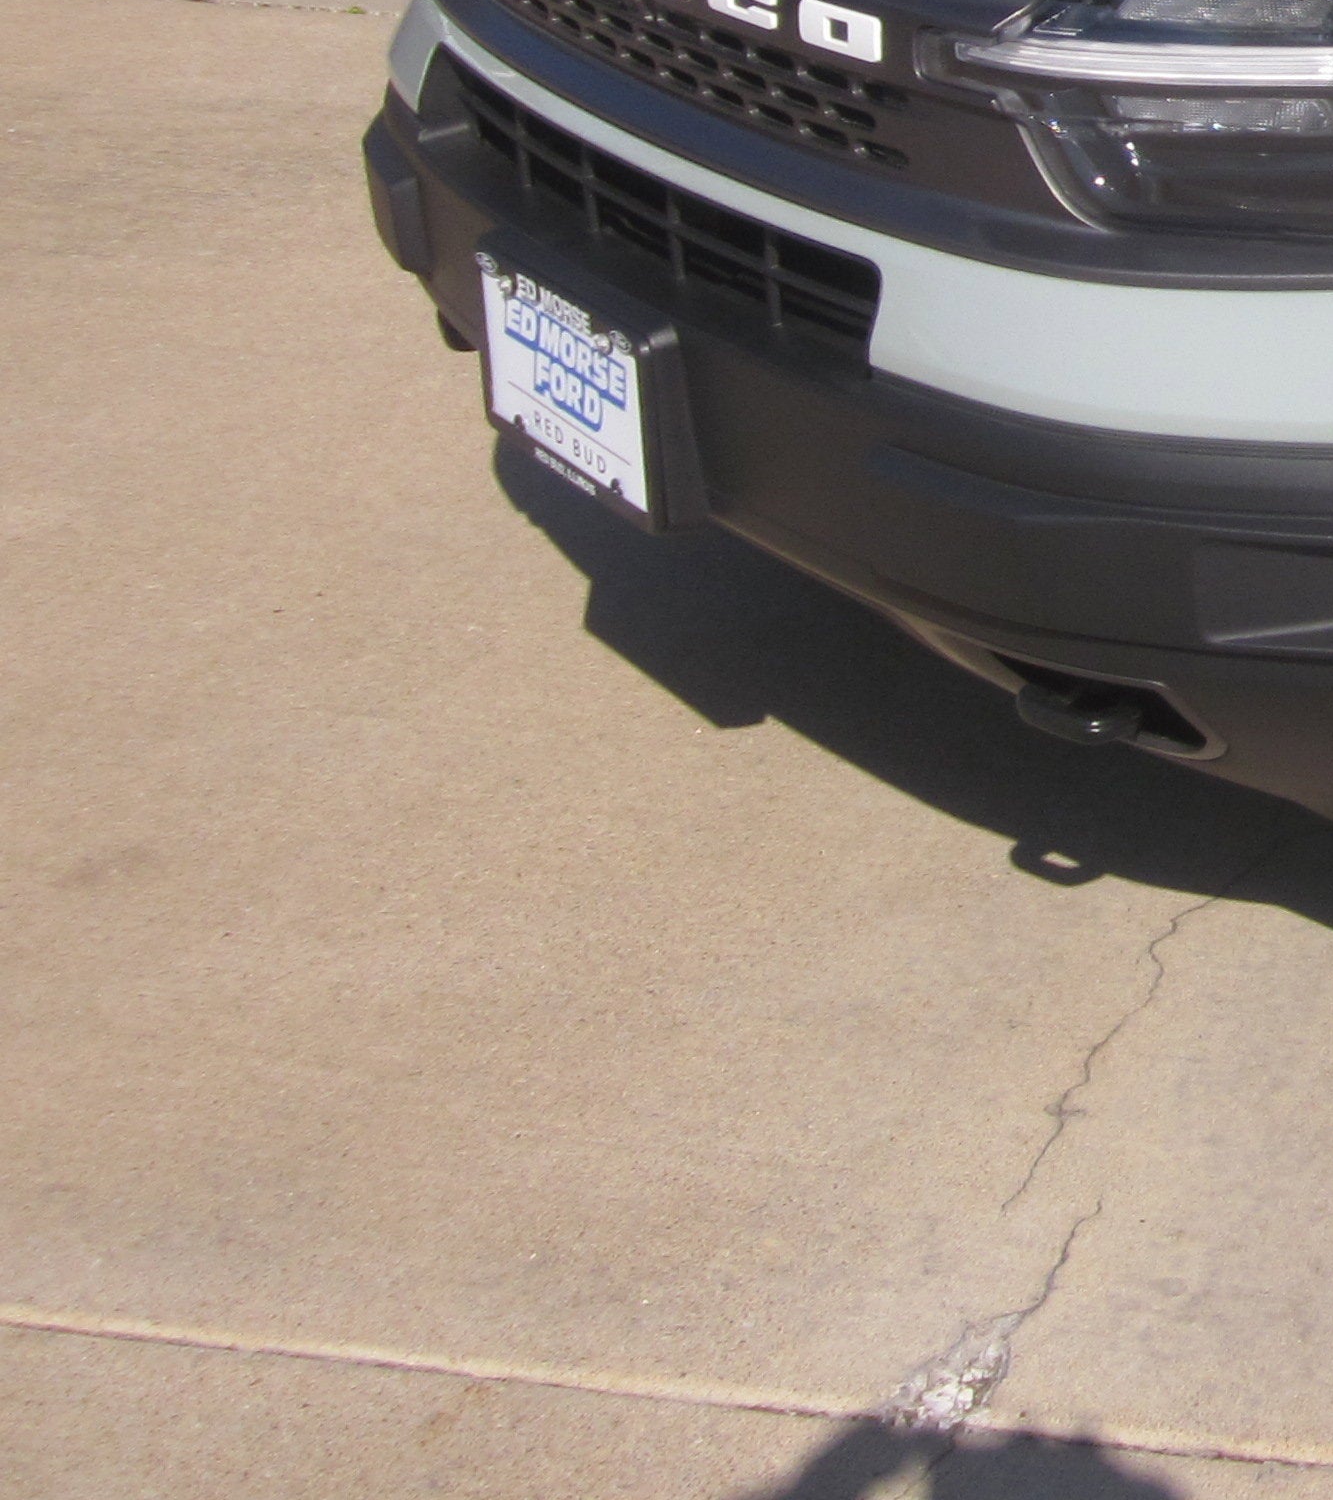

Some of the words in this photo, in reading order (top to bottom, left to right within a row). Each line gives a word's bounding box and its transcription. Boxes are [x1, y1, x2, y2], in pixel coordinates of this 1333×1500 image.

[505, 297, 539, 350] ED
[538, 312, 627, 411] MORSE
[534, 351, 604, 432] FORD
[534, 410, 564, 445] RED
[573, 438, 606, 474] BUD
